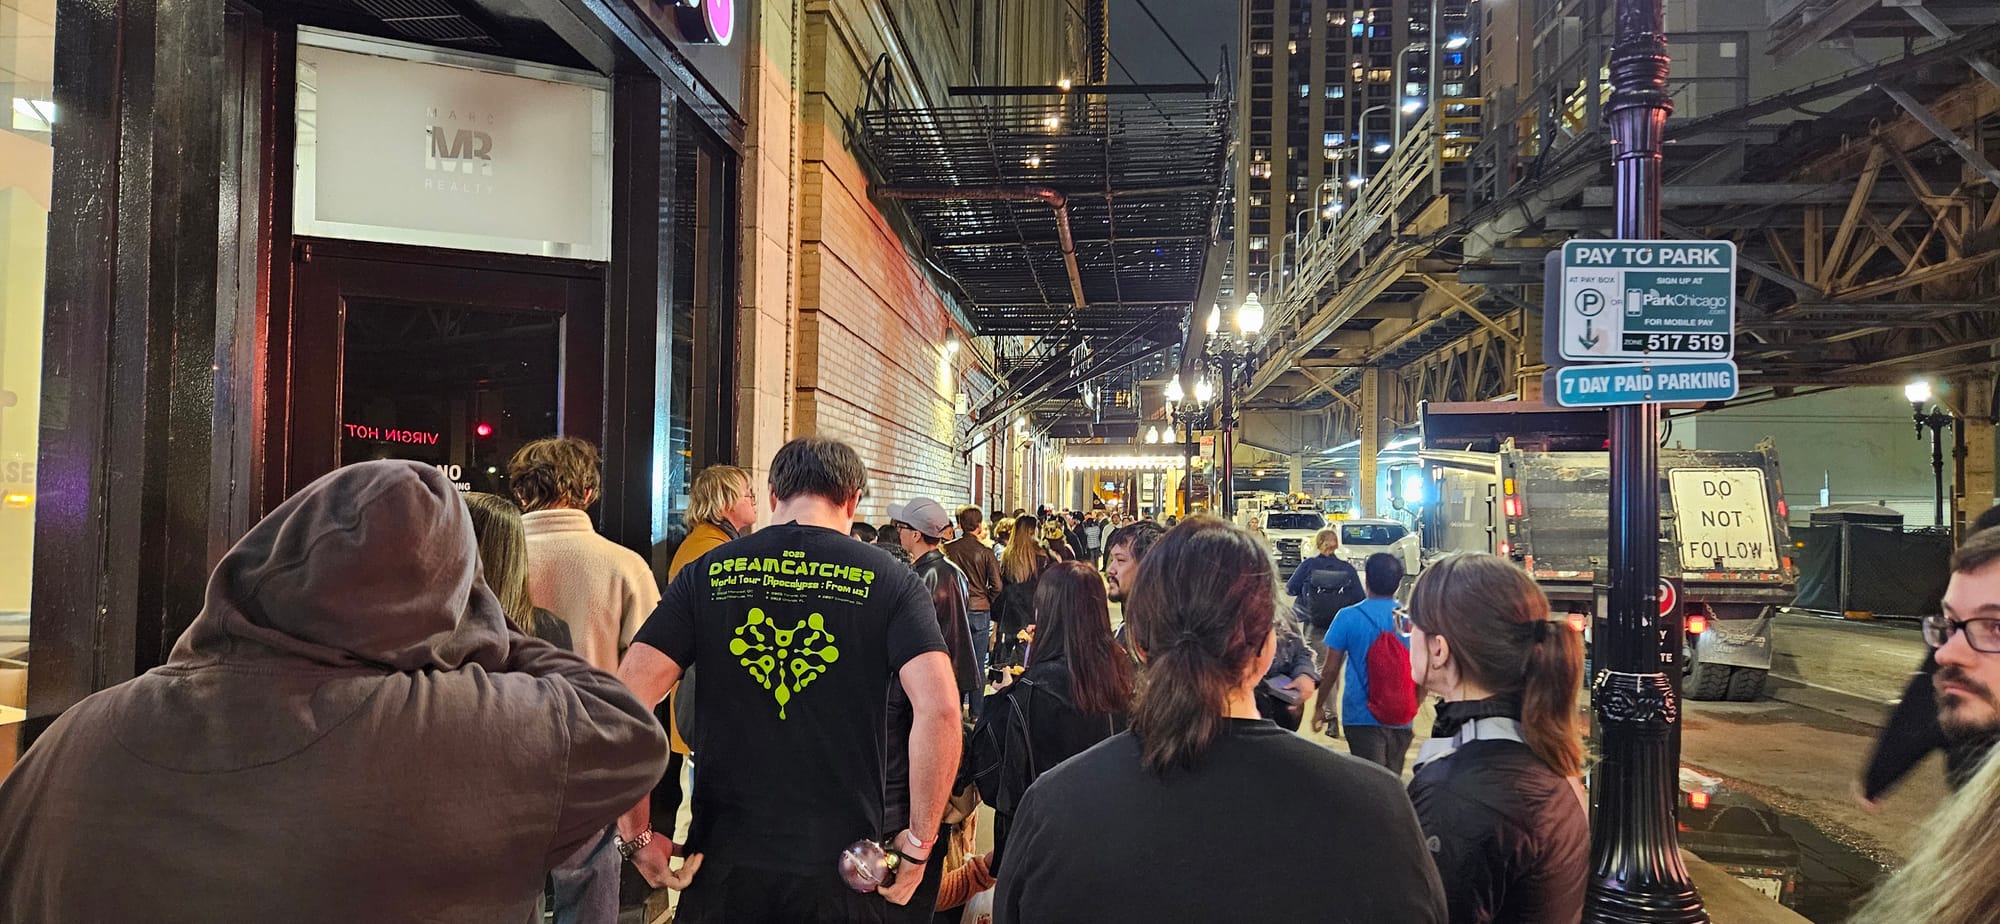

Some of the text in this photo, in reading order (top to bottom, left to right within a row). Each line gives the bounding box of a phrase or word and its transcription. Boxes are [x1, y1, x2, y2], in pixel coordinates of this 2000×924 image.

[425, 106, 495, 125] MARC
[425, 125, 494, 177] MR
[425, 178, 494, 195] REALTY
[1575, 247, 1720, 265] PAY TO PARK
[1598, 276, 1615, 284] BOX
[1656, 277, 1704, 285] SIGN UP AT
[1643, 292, 1727, 309] ParkChicago
[1644, 318, 1714, 327] FOR MOBILE PAY
[1647, 335, 1683, 351] 517
[1688, 334, 1724, 351] 519
[1563, 371, 1731, 394] 7 DAY PAID PARKING
[436, 464, 462, 481] NO
[1703, 480, 1732, 497] DO
[1701, 510, 1742, 528] NOT
[782, 550, 805, 559] 2023
[1690, 541, 1762, 559] FOLLOW
[708, 557, 875, 585] DREAMCATCHER
[711, 575, 738, 588] World
[738, 574, 761, 585] Tour
